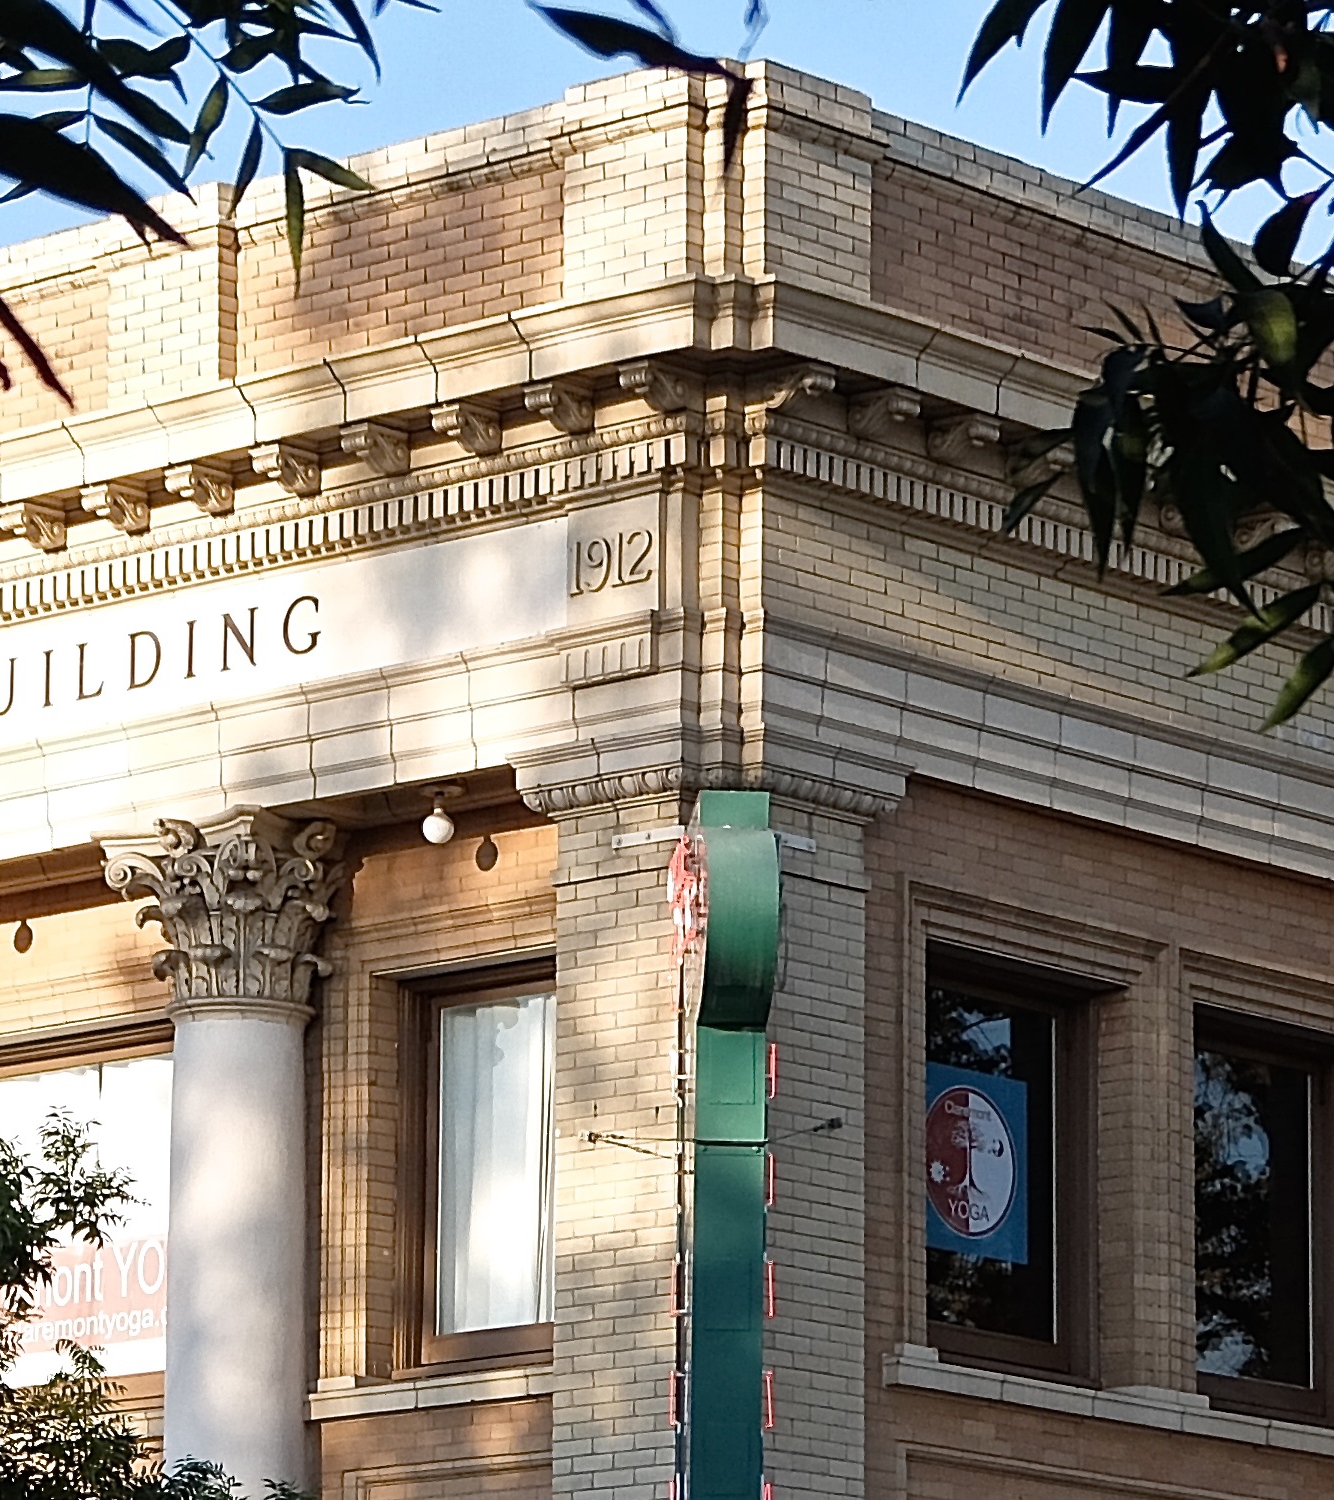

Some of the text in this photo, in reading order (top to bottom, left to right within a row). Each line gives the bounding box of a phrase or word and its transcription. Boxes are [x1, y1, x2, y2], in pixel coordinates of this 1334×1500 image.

[570, 529, 653, 598] 1912
[948, 1199, 990, 1222] YOGA
[113, 1239, 166, 1298] YO
